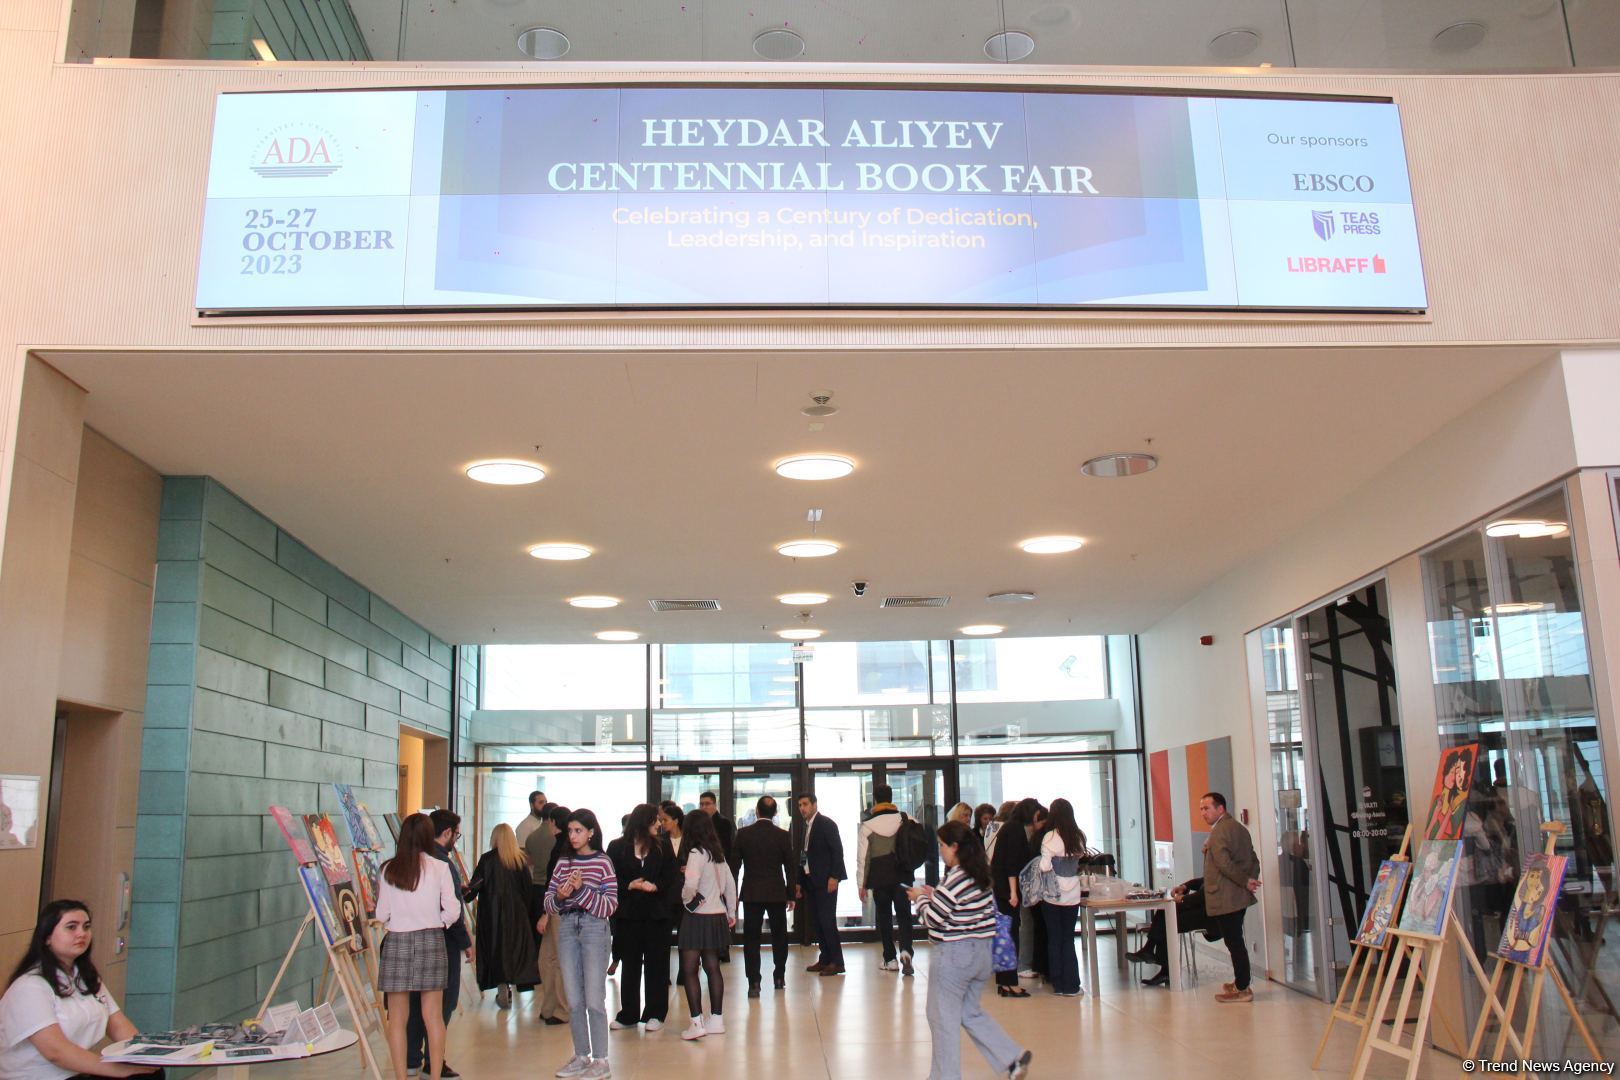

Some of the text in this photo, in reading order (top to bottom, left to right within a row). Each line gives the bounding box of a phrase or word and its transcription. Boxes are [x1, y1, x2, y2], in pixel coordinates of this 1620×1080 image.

[642, 118, 1003, 149] HEYDAR ALIYEV
[1267, 133, 1368, 148] Our sponsors
[261, 137, 332, 164] ADA
[548, 162, 1099, 195] CENTENNIAL BOOK FAIR
[1293, 173, 1375, 193] EBSCO
[245, 208, 317, 229] 25-27
[612, 206, 1039, 231] Celebrating a Century of Dedication,
[1340, 211, 1379, 224] TEAS
[1343, 224, 1381, 235] PRESS
[243, 230, 394, 251] OCTOBER
[667, 230, 986, 252] Leadership, and Inspiration
[240, 255, 302, 275] 2023
[1287, 257, 1369, 273] LIBRAFF
